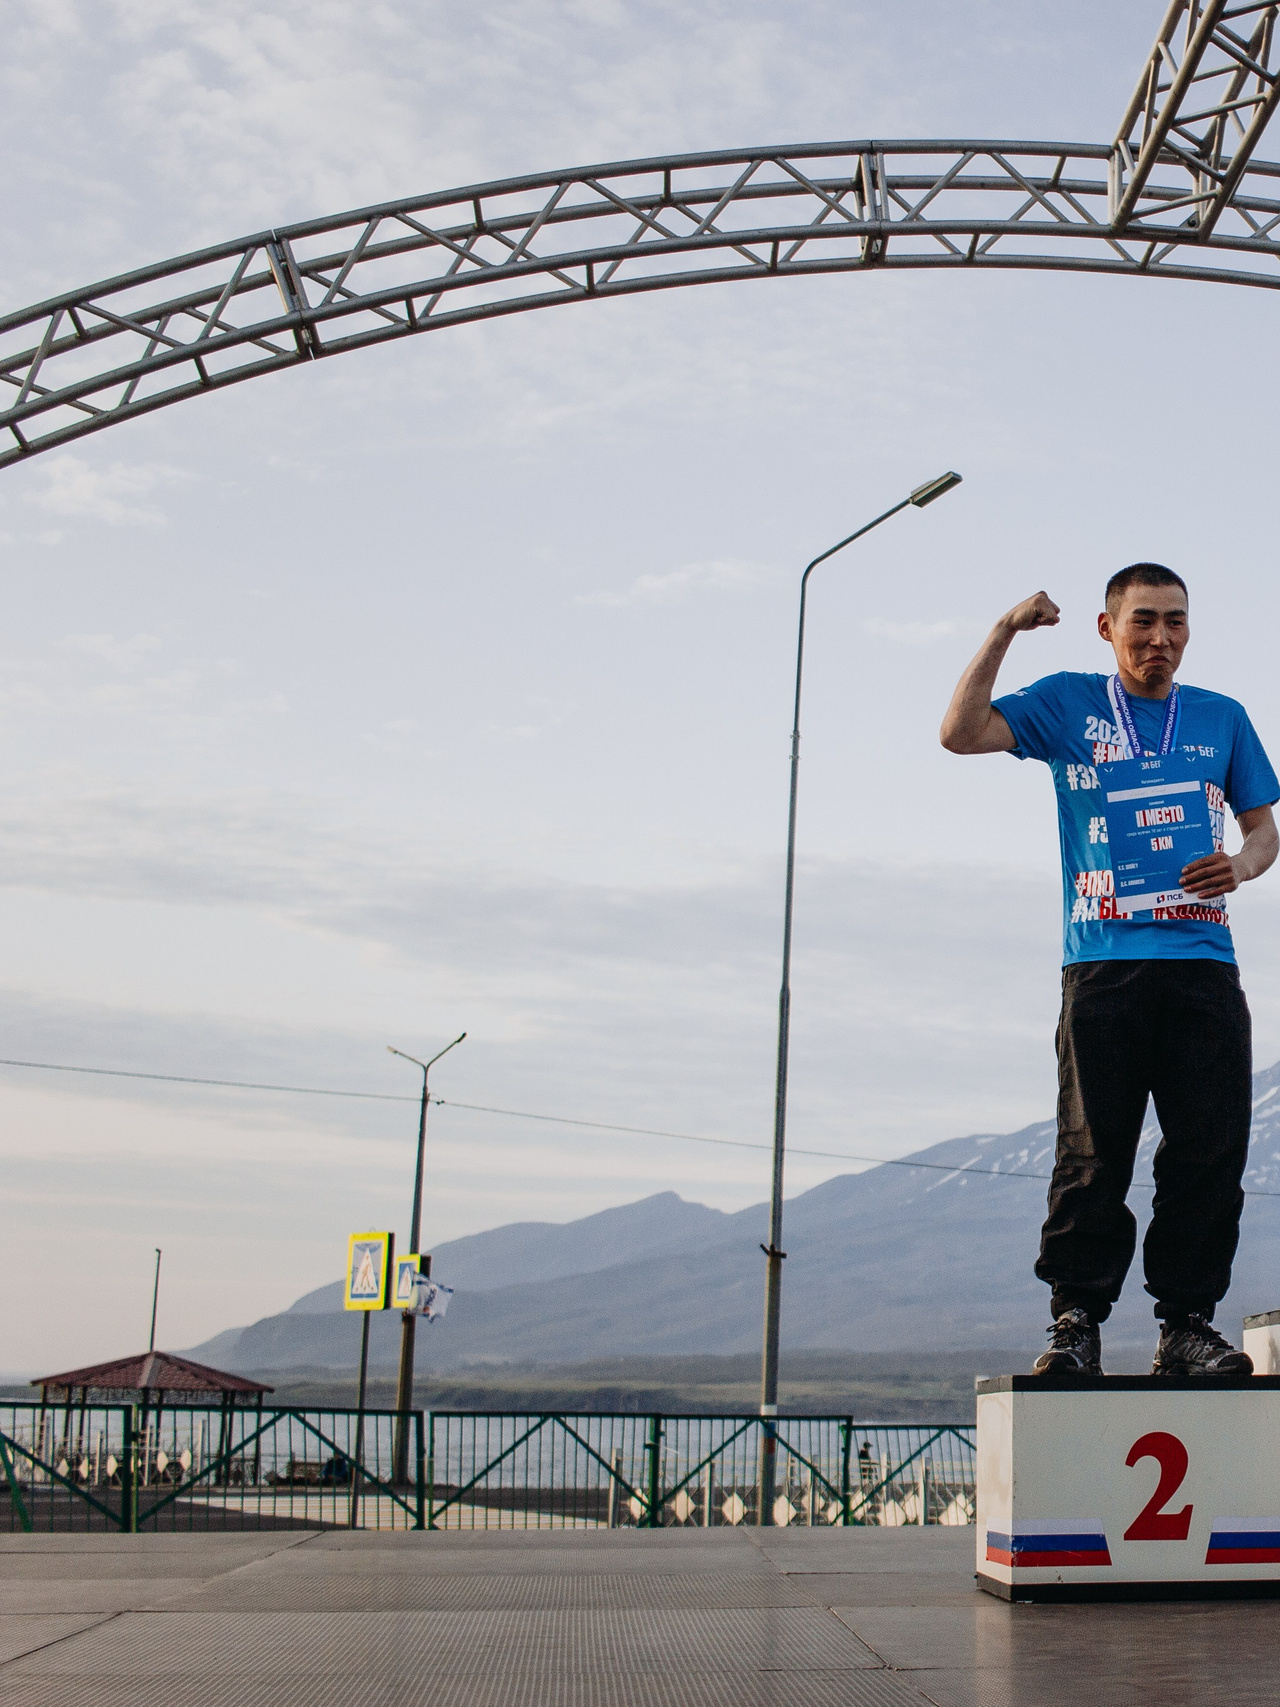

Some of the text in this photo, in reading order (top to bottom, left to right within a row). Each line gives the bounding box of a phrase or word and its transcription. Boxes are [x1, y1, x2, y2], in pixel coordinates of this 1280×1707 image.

[1146, 805, 1185, 826] МЕСТО
[1150, 836, 1174, 852] 5 КМ
[1166, 893, 1184, 901] ПСБ
[1123, 1431, 1194, 1541] 2
